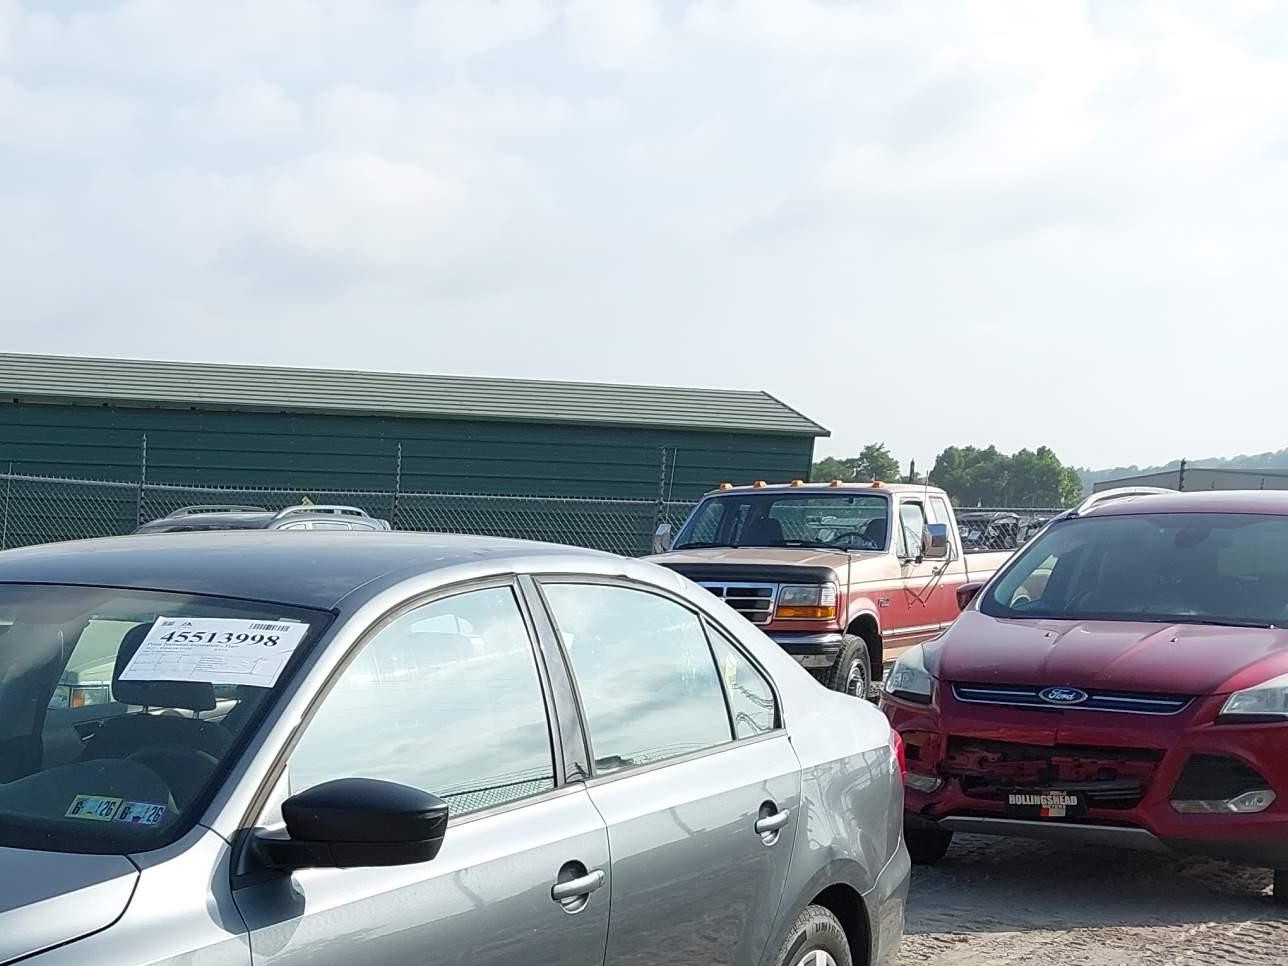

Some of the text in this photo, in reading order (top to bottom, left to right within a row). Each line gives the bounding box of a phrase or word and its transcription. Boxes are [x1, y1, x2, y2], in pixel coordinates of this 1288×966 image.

[160, 630, 280, 648] 45513998
[1048, 688, 1077, 701] Ford
[1008, 794, 1078, 806] HOLLINGSHEAD
